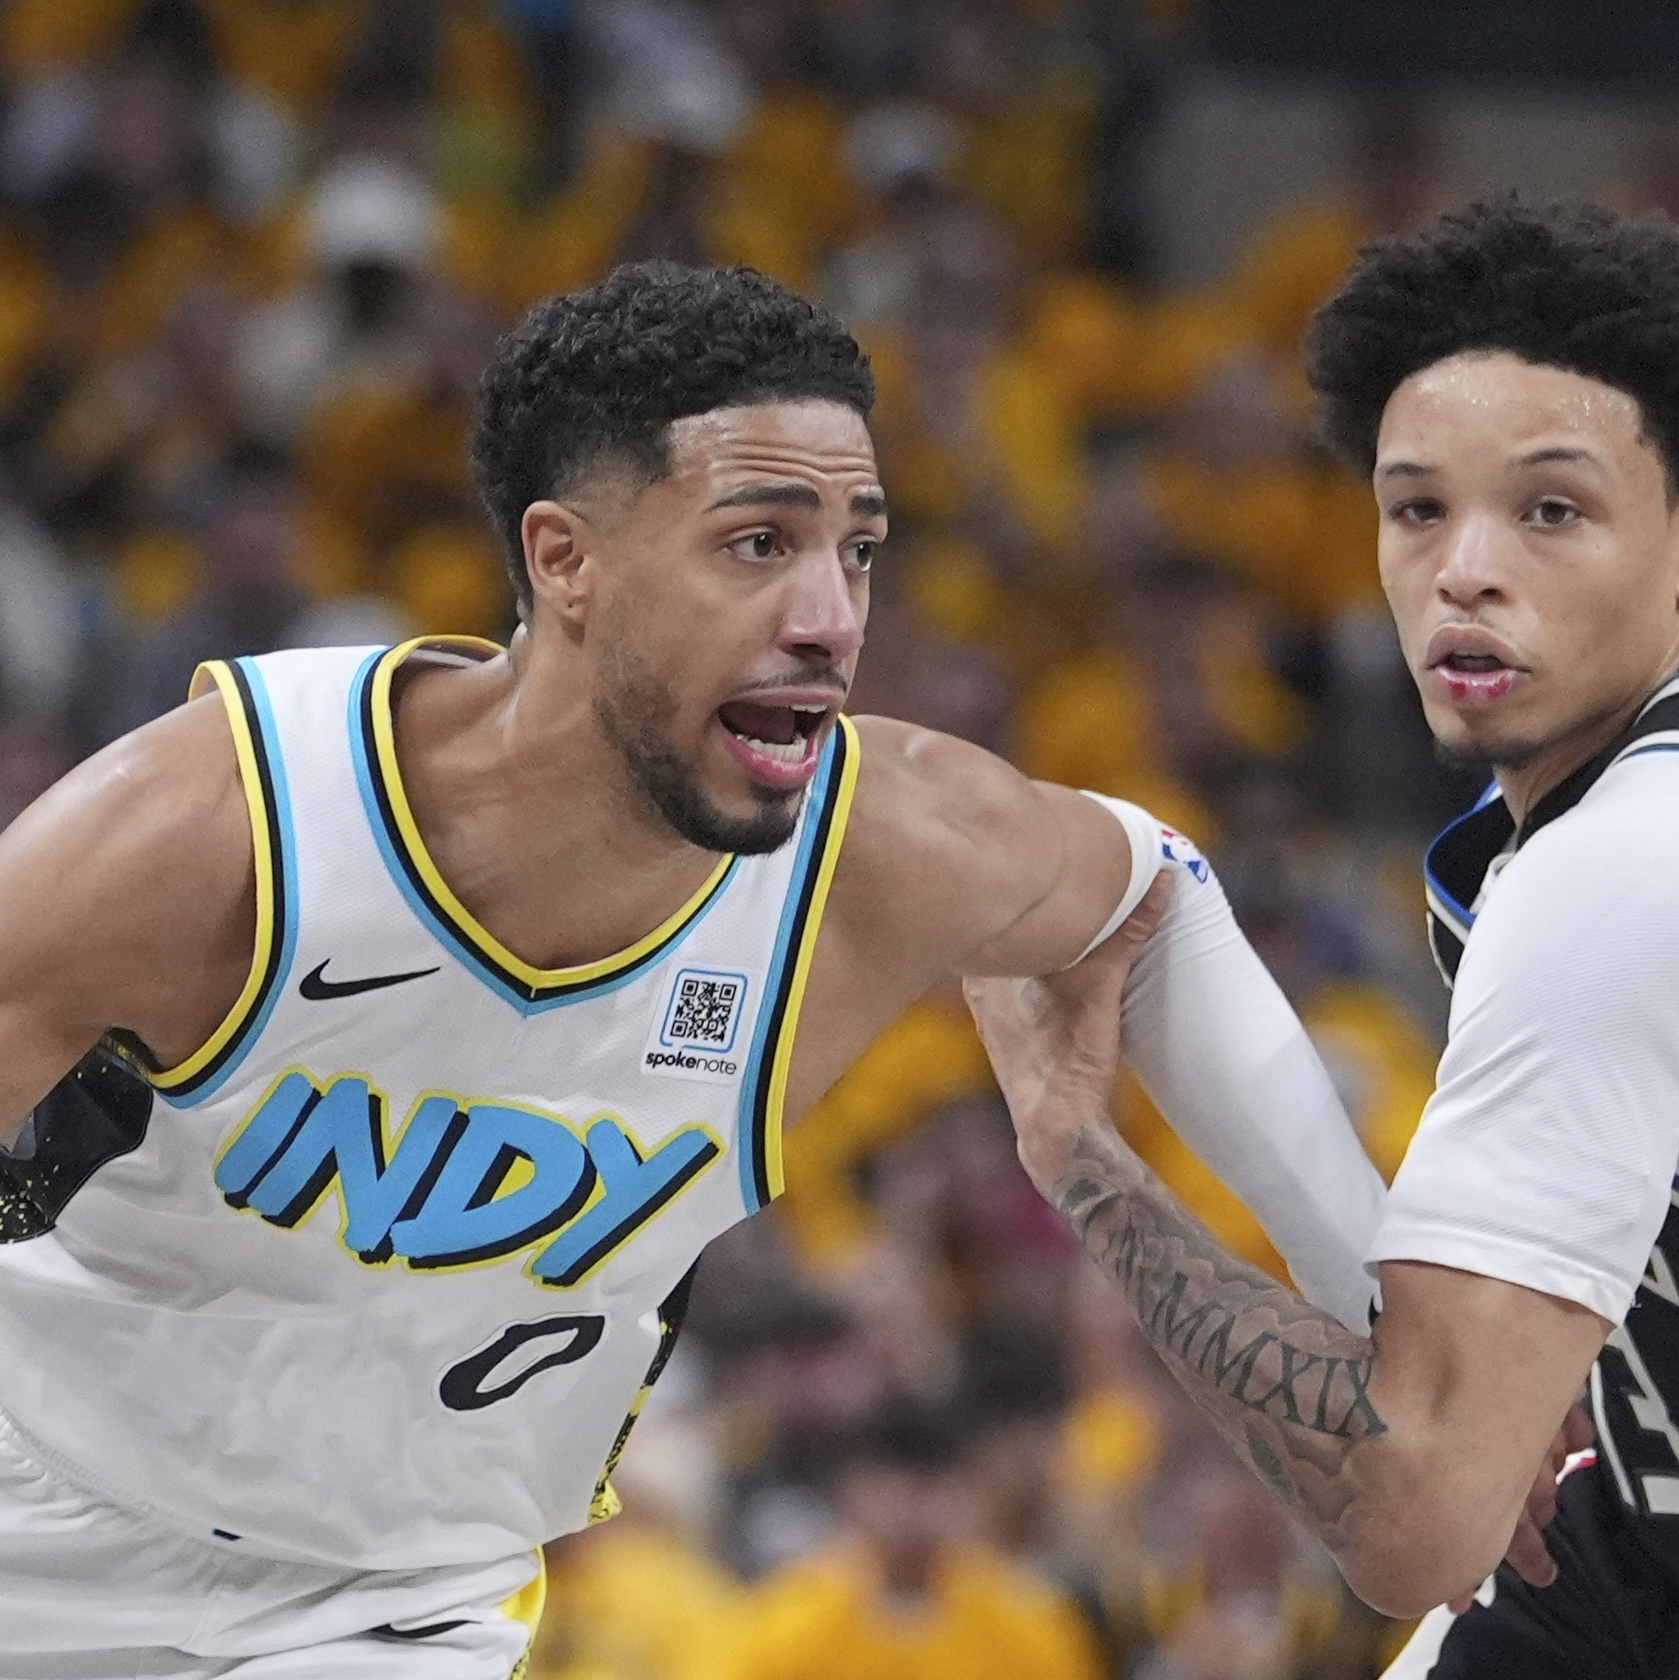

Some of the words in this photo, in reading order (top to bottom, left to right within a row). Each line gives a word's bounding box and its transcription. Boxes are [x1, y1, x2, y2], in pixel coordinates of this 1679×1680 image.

[645, 1051, 737, 1075] spokenote
[214, 1064, 725, 1290] INDY
[439, 1314, 606, 1412] 0
